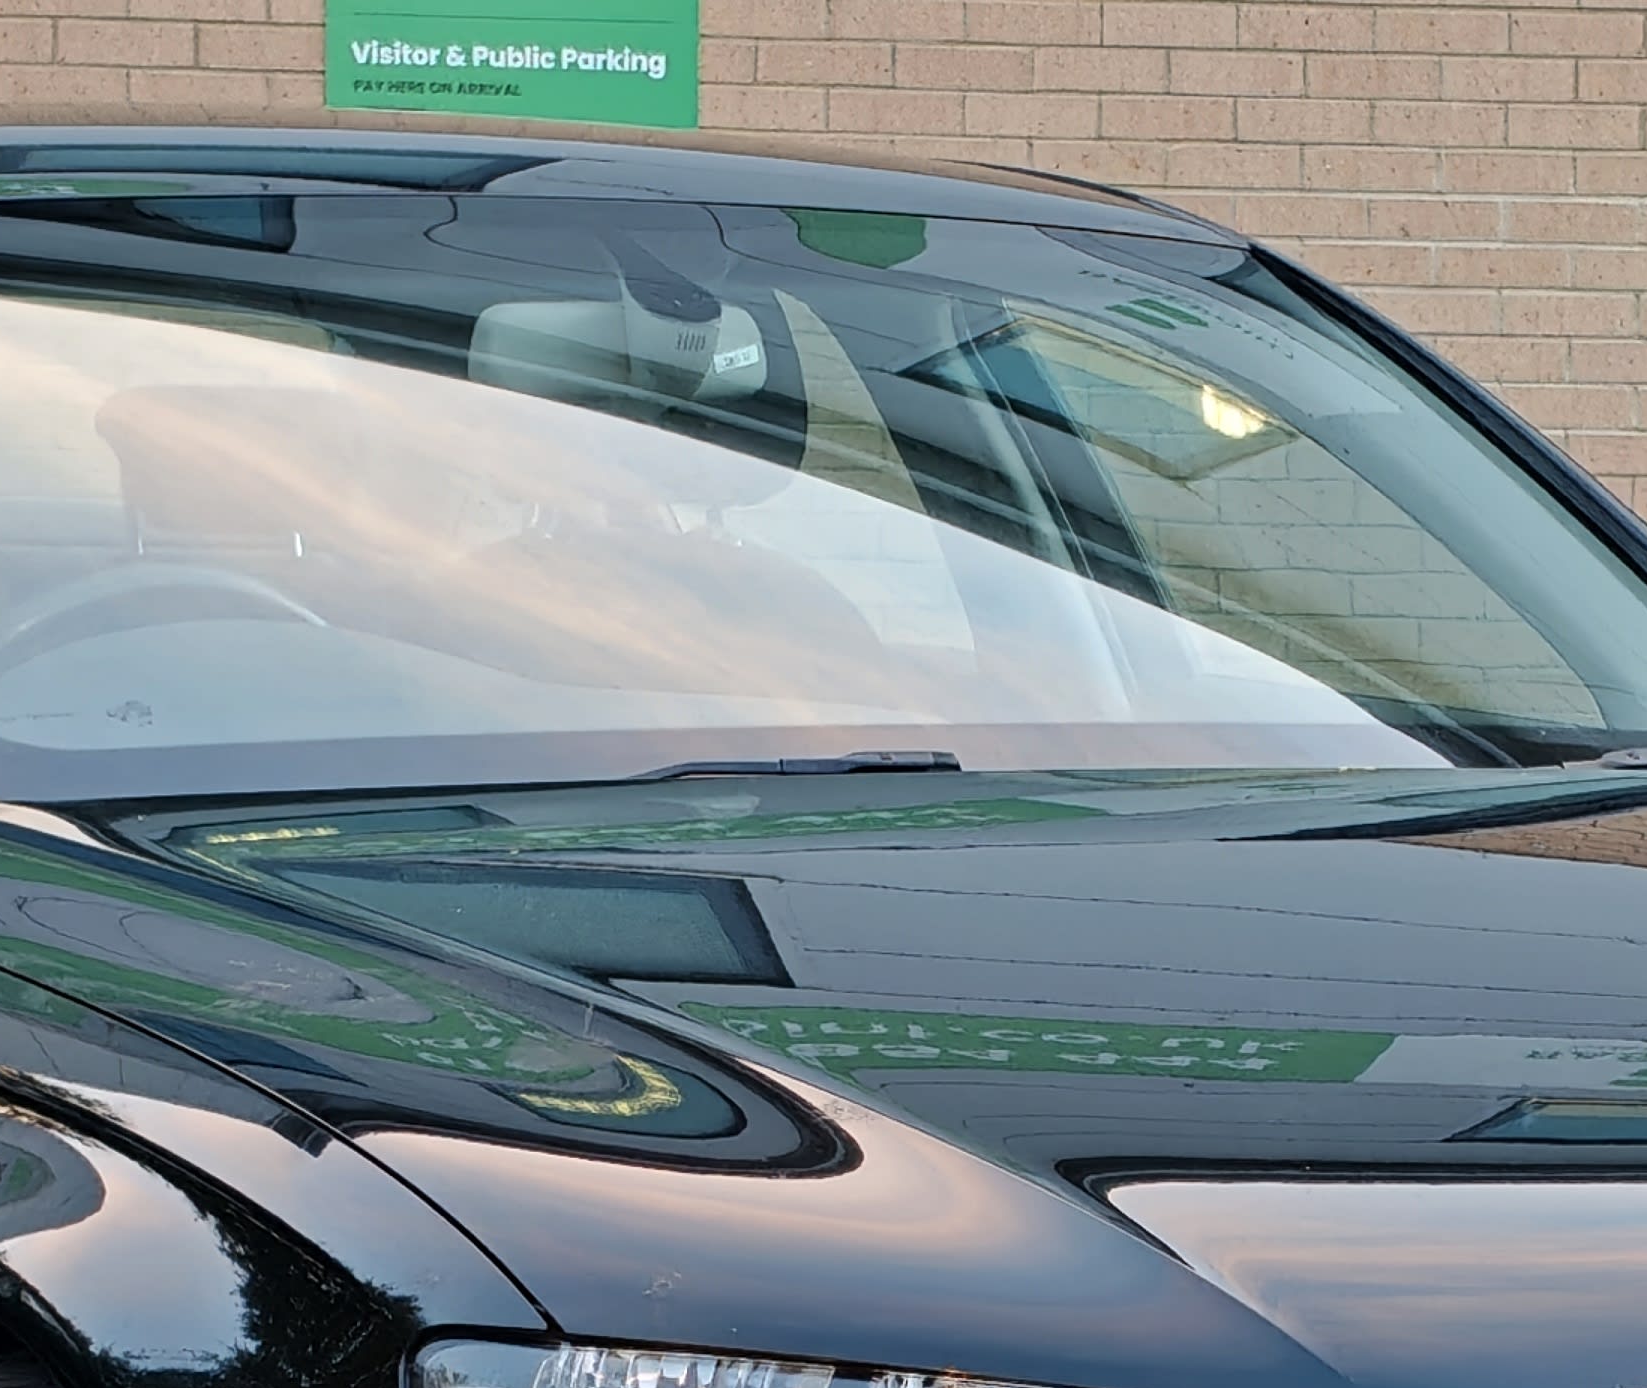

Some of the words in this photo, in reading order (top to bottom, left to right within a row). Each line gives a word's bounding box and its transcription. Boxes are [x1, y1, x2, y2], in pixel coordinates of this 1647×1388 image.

[352, 40, 440, 66] Visitor
[446, 45, 466, 67] &
[472, 45, 556, 69] Public
[561, 47, 666, 79] Parking
[353, 79, 385, 92] PAY
[428, 81, 454, 95] ON
